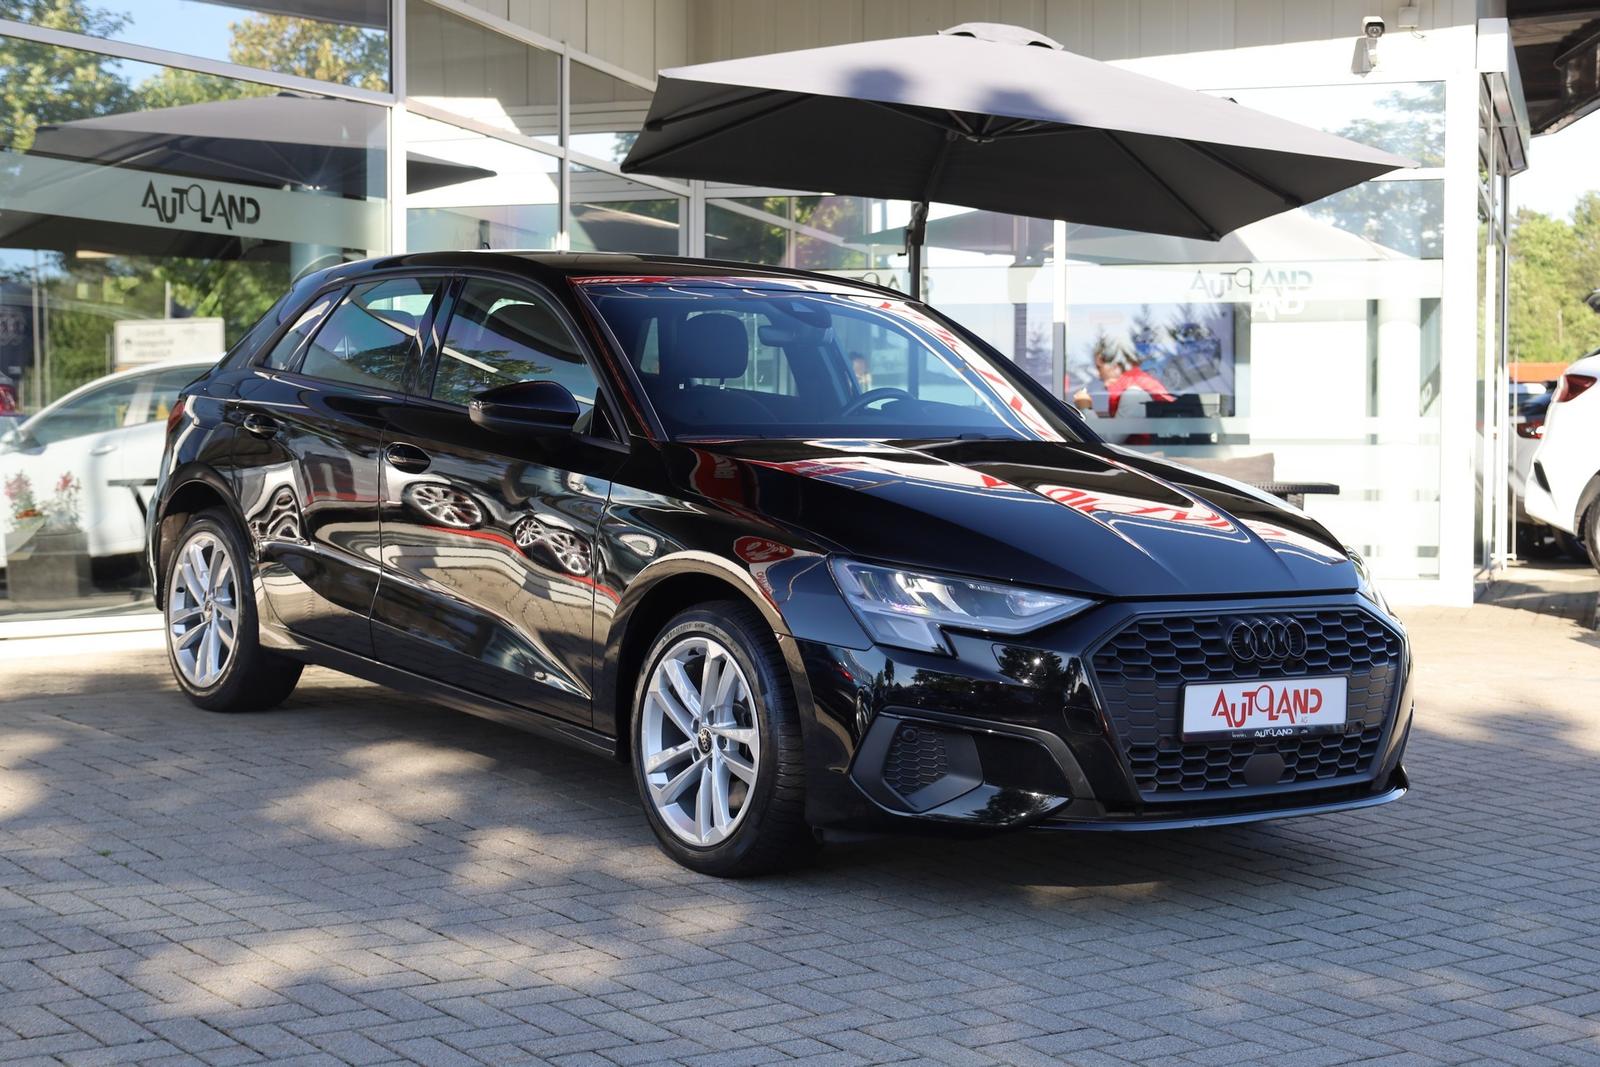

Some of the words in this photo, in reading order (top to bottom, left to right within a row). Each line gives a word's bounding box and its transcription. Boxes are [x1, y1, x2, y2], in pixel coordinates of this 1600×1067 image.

[142, 180, 260, 230] AUTOLAND
[1212, 684, 1323, 728] AUTOLAND
[1254, 728, 1293, 737] AUTOLAND
